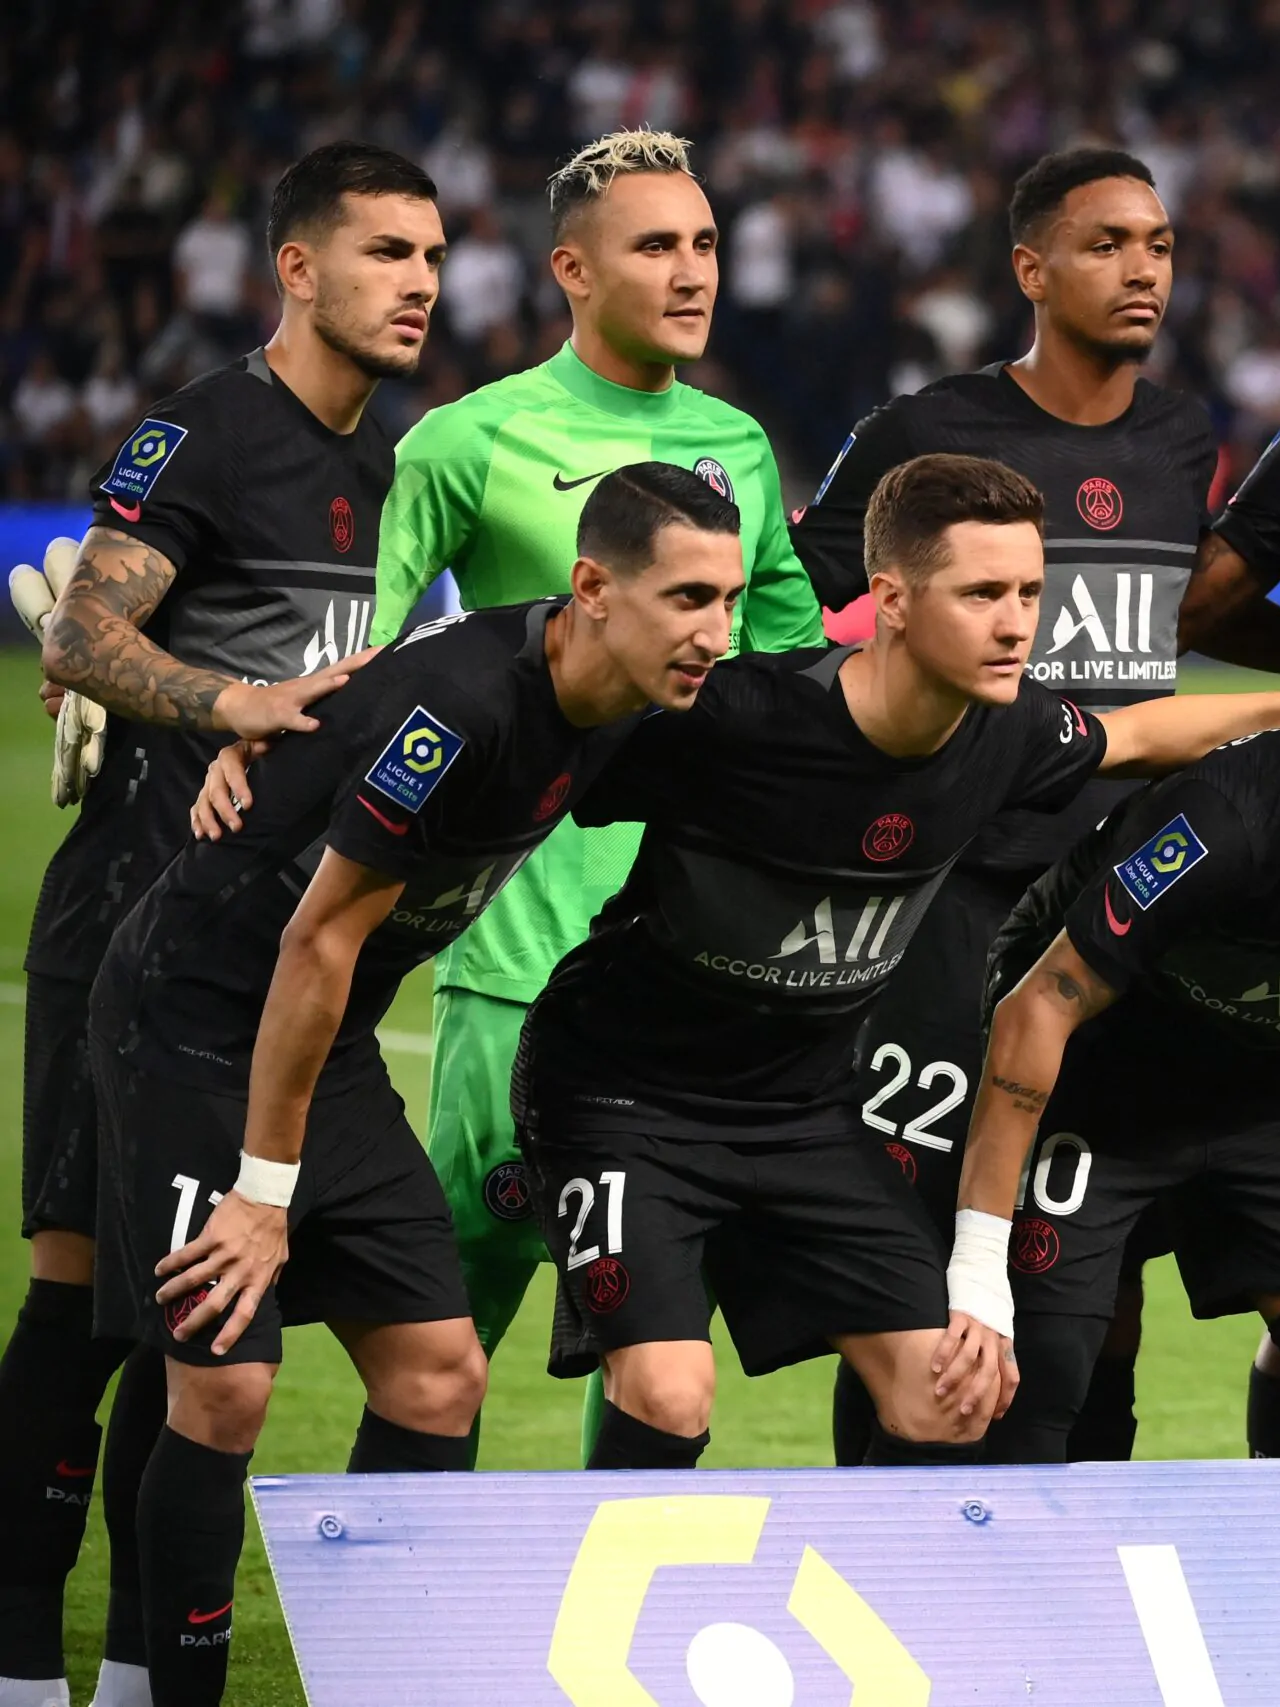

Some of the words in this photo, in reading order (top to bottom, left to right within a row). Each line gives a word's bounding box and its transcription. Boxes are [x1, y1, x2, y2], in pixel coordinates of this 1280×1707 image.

[111, 478, 127, 489] Uber
[118, 467, 143, 481] LIGUE
[143, 475, 149, 483] 1
[1082, 480, 1113, 494] PARIS
[1071, 661, 1115, 680] LIVE
[377, 768, 398, 788] Uber
[397, 784, 418, 802] Eats
[386, 761, 418, 786] LIGUE
[417, 782, 424, 791] 1
[877, 816, 909, 830] PARIS
[1125, 862, 1138, 880] Uber
[1134, 878, 1150, 899] Eats
[1134, 857, 1155, 883] LIGUE
[1151, 881, 1159, 889] 1
[694, 951, 782, 984] ACCOR
[786, 970, 836, 987] LIVE
[861, 1043, 968, 1153] 22
[171, 1173, 224, 1254] 1
[557, 1171, 626, 1271] 21
